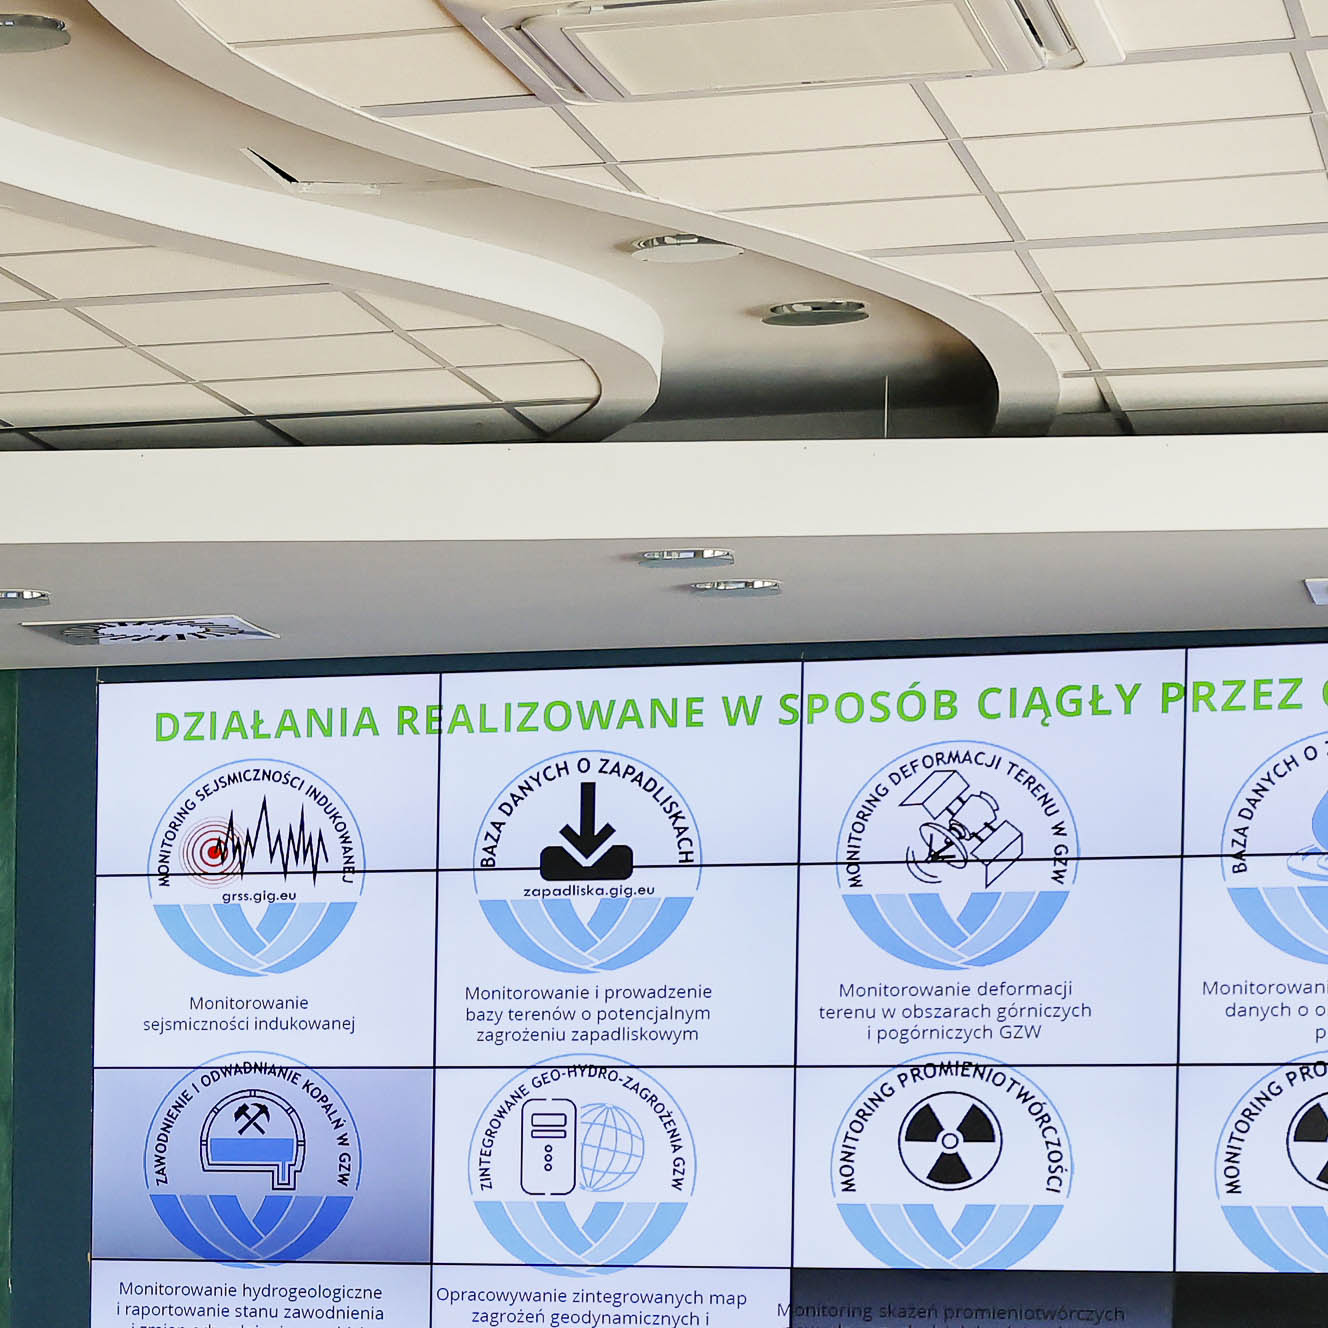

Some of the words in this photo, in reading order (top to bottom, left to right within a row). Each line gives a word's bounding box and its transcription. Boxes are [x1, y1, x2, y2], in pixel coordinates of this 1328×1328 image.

[155, 706, 380, 743] DZIAŁANIA
[397, 695, 705, 737] REALIZOWANE
[723, 694, 762, 727] W
[778, 682, 958, 726] SPOSÓB
[977, 682, 1142, 727] CIĄGŁY
[1161, 678, 1304, 715] PRZEZ
[1303, 745, 1318, 761] O
[1237, 754, 1300, 821] DANYCH
[480, 820, 506, 868] BAZA
[497, 760, 570, 817] DANYCH
[577, 757, 591, 773] O
[598, 758, 695, 864] ZAPADLISKACH
[845, 783, 889, 888] MONITORING
[888, 750, 1002, 786] DEFORMACJI
[1006, 761, 1060, 818] TERENU
[157, 798, 197, 887] MONITORING
[195, 768, 305, 802] SEJSMICZNOŚCI
[305, 784, 355, 884] INDUKOWANEJ
[1231, 826, 1250, 874] BAZA
[222, 890, 297, 904] grss.gig.eu
[523, 884, 655, 898] zapadliska.gig.eu
[464, 984, 591, 1003] Monitorowanie
[604, 983, 713, 1006] prowadzenie
[839, 981, 971, 999] Monitorowanie
[976, 979, 1073, 1001] deformacji
[189, 994, 309, 1012] Monitorowanie
[819, 1003, 878, 1020] terenu
[901, 1002, 991, 1020] obszarach
[996, 1000, 1092, 1024] górniczych
[1225, 1002, 1291, 1022] danych
[1297, 1004, 1309, 1018] o
[143, 1014, 249, 1035] sejsmiczności
[253, 1016, 356, 1035] indukowanej
[465, 1006, 505, 1027] bazy
[509, 1005, 577, 1023] terenów
[596, 1004, 711, 1026] potencjalnym
[476, 1026, 567, 1046] zagrożeniu
[571, 1025, 699, 1047] zapadliskowym
[877, 1023, 996, 1045] pogórniczych
[999, 1024, 1042, 1040] GZW
[154, 1089, 194, 1186] ZAWODNIENIE
[301, 1079, 347, 1130] KOPALŃ
[337, 1152, 352, 1188] GZW
[479, 1084, 530, 1191] ZINTEGROWANE
[671, 1156, 686, 1192] GZW
[839, 1082, 896, 1193] MONITORING
[897, 1060, 1069, 1194] PROMIENIOTWÓRCZOŚCI
[1223, 1081, 1284, 1194] MONITORING
[119, 1281, 237, 1298] Monitorowanie
[242, 1283, 383, 1303] hydrogeologiczne
[436, 1287, 567, 1306] Opracowywanie
[572, 1289, 703, 1307] zintegrowanych
[709, 1292, 747, 1308] map
[125, 1302, 230, 1320] raportowanie
[235, 1306, 278, 1319] stanu
[283, 1304, 385, 1321] zawodnienia
[471, 1308, 545, 1327] zagrożeń
[550, 1310, 700, 1328] geodynamicznych
